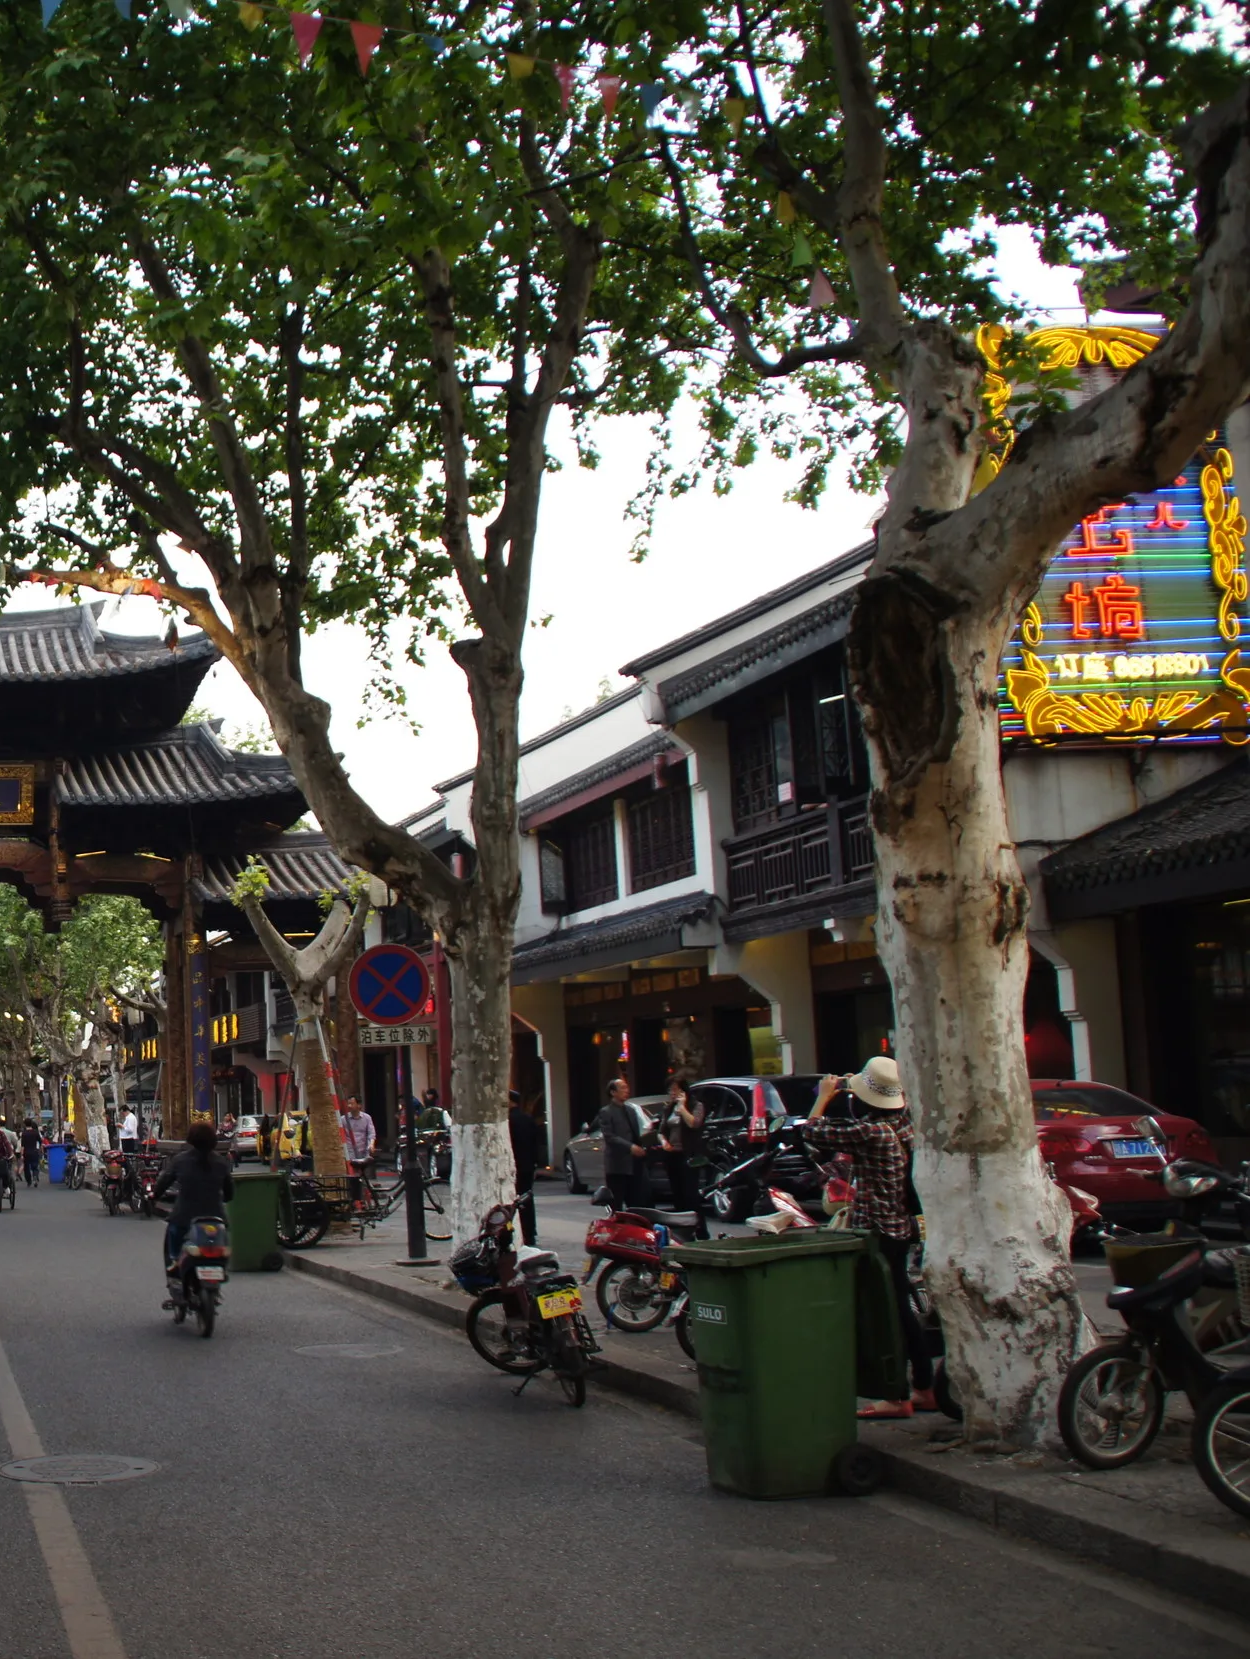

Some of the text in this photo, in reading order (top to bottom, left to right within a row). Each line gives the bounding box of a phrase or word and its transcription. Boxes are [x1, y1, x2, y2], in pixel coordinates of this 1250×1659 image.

[361, 1027, 430, 1044] 泊车位除外
[697, 1306, 723, 1321] SULO
